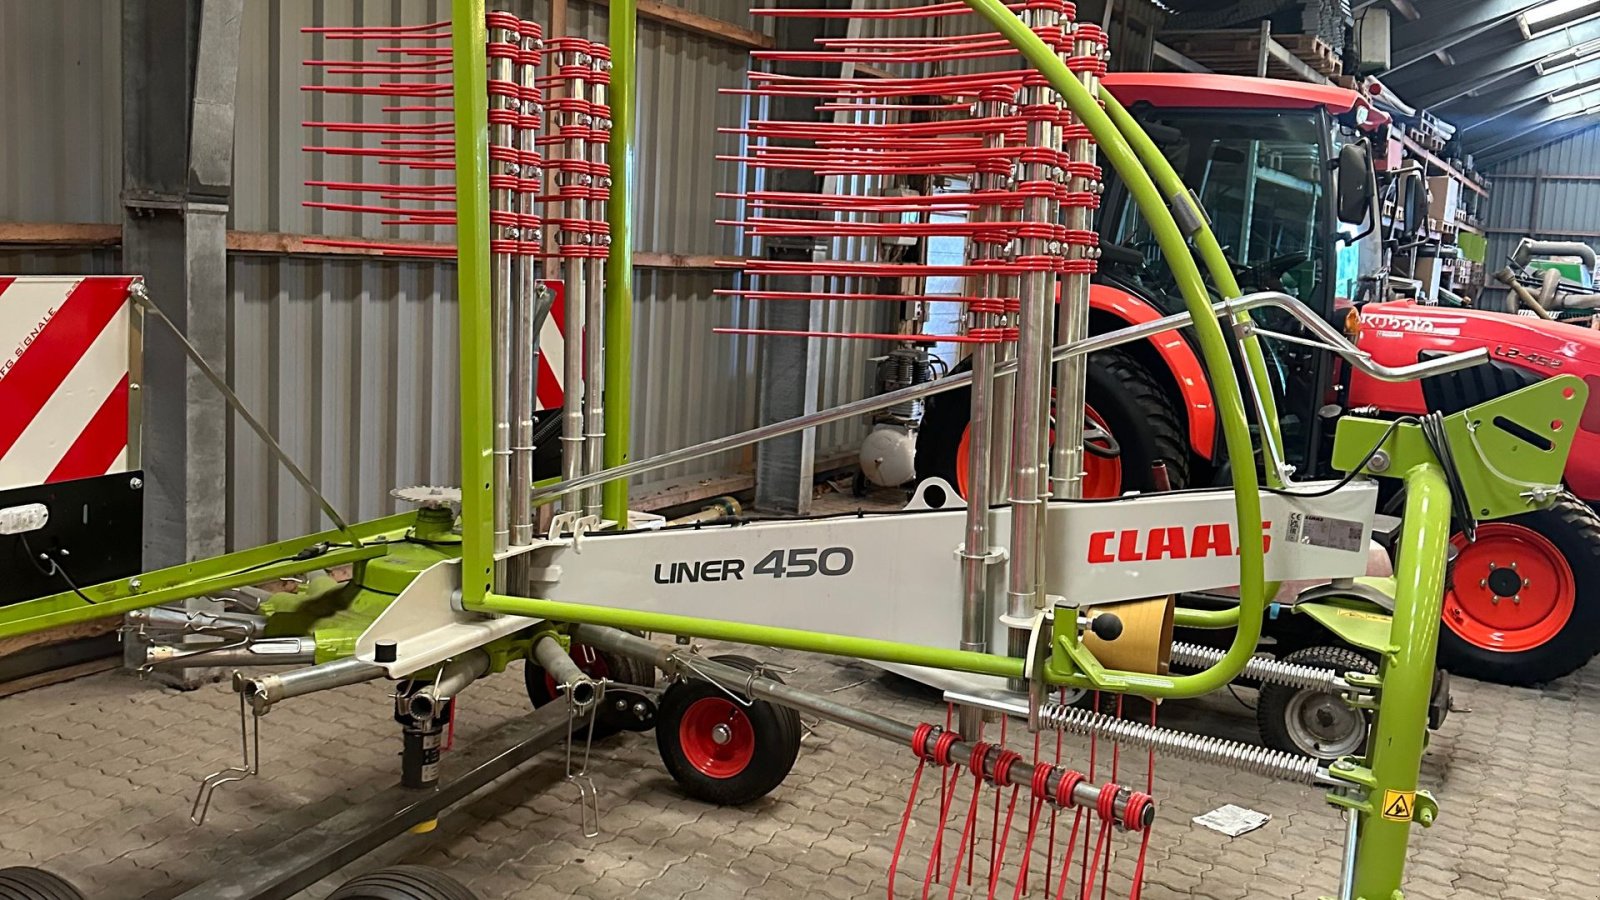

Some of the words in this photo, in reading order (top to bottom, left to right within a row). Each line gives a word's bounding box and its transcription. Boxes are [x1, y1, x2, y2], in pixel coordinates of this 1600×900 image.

[14, 307, 57, 358] SIGNALE
[653, 558, 746, 585] LINER
[752, 546, 854, 579] 450
